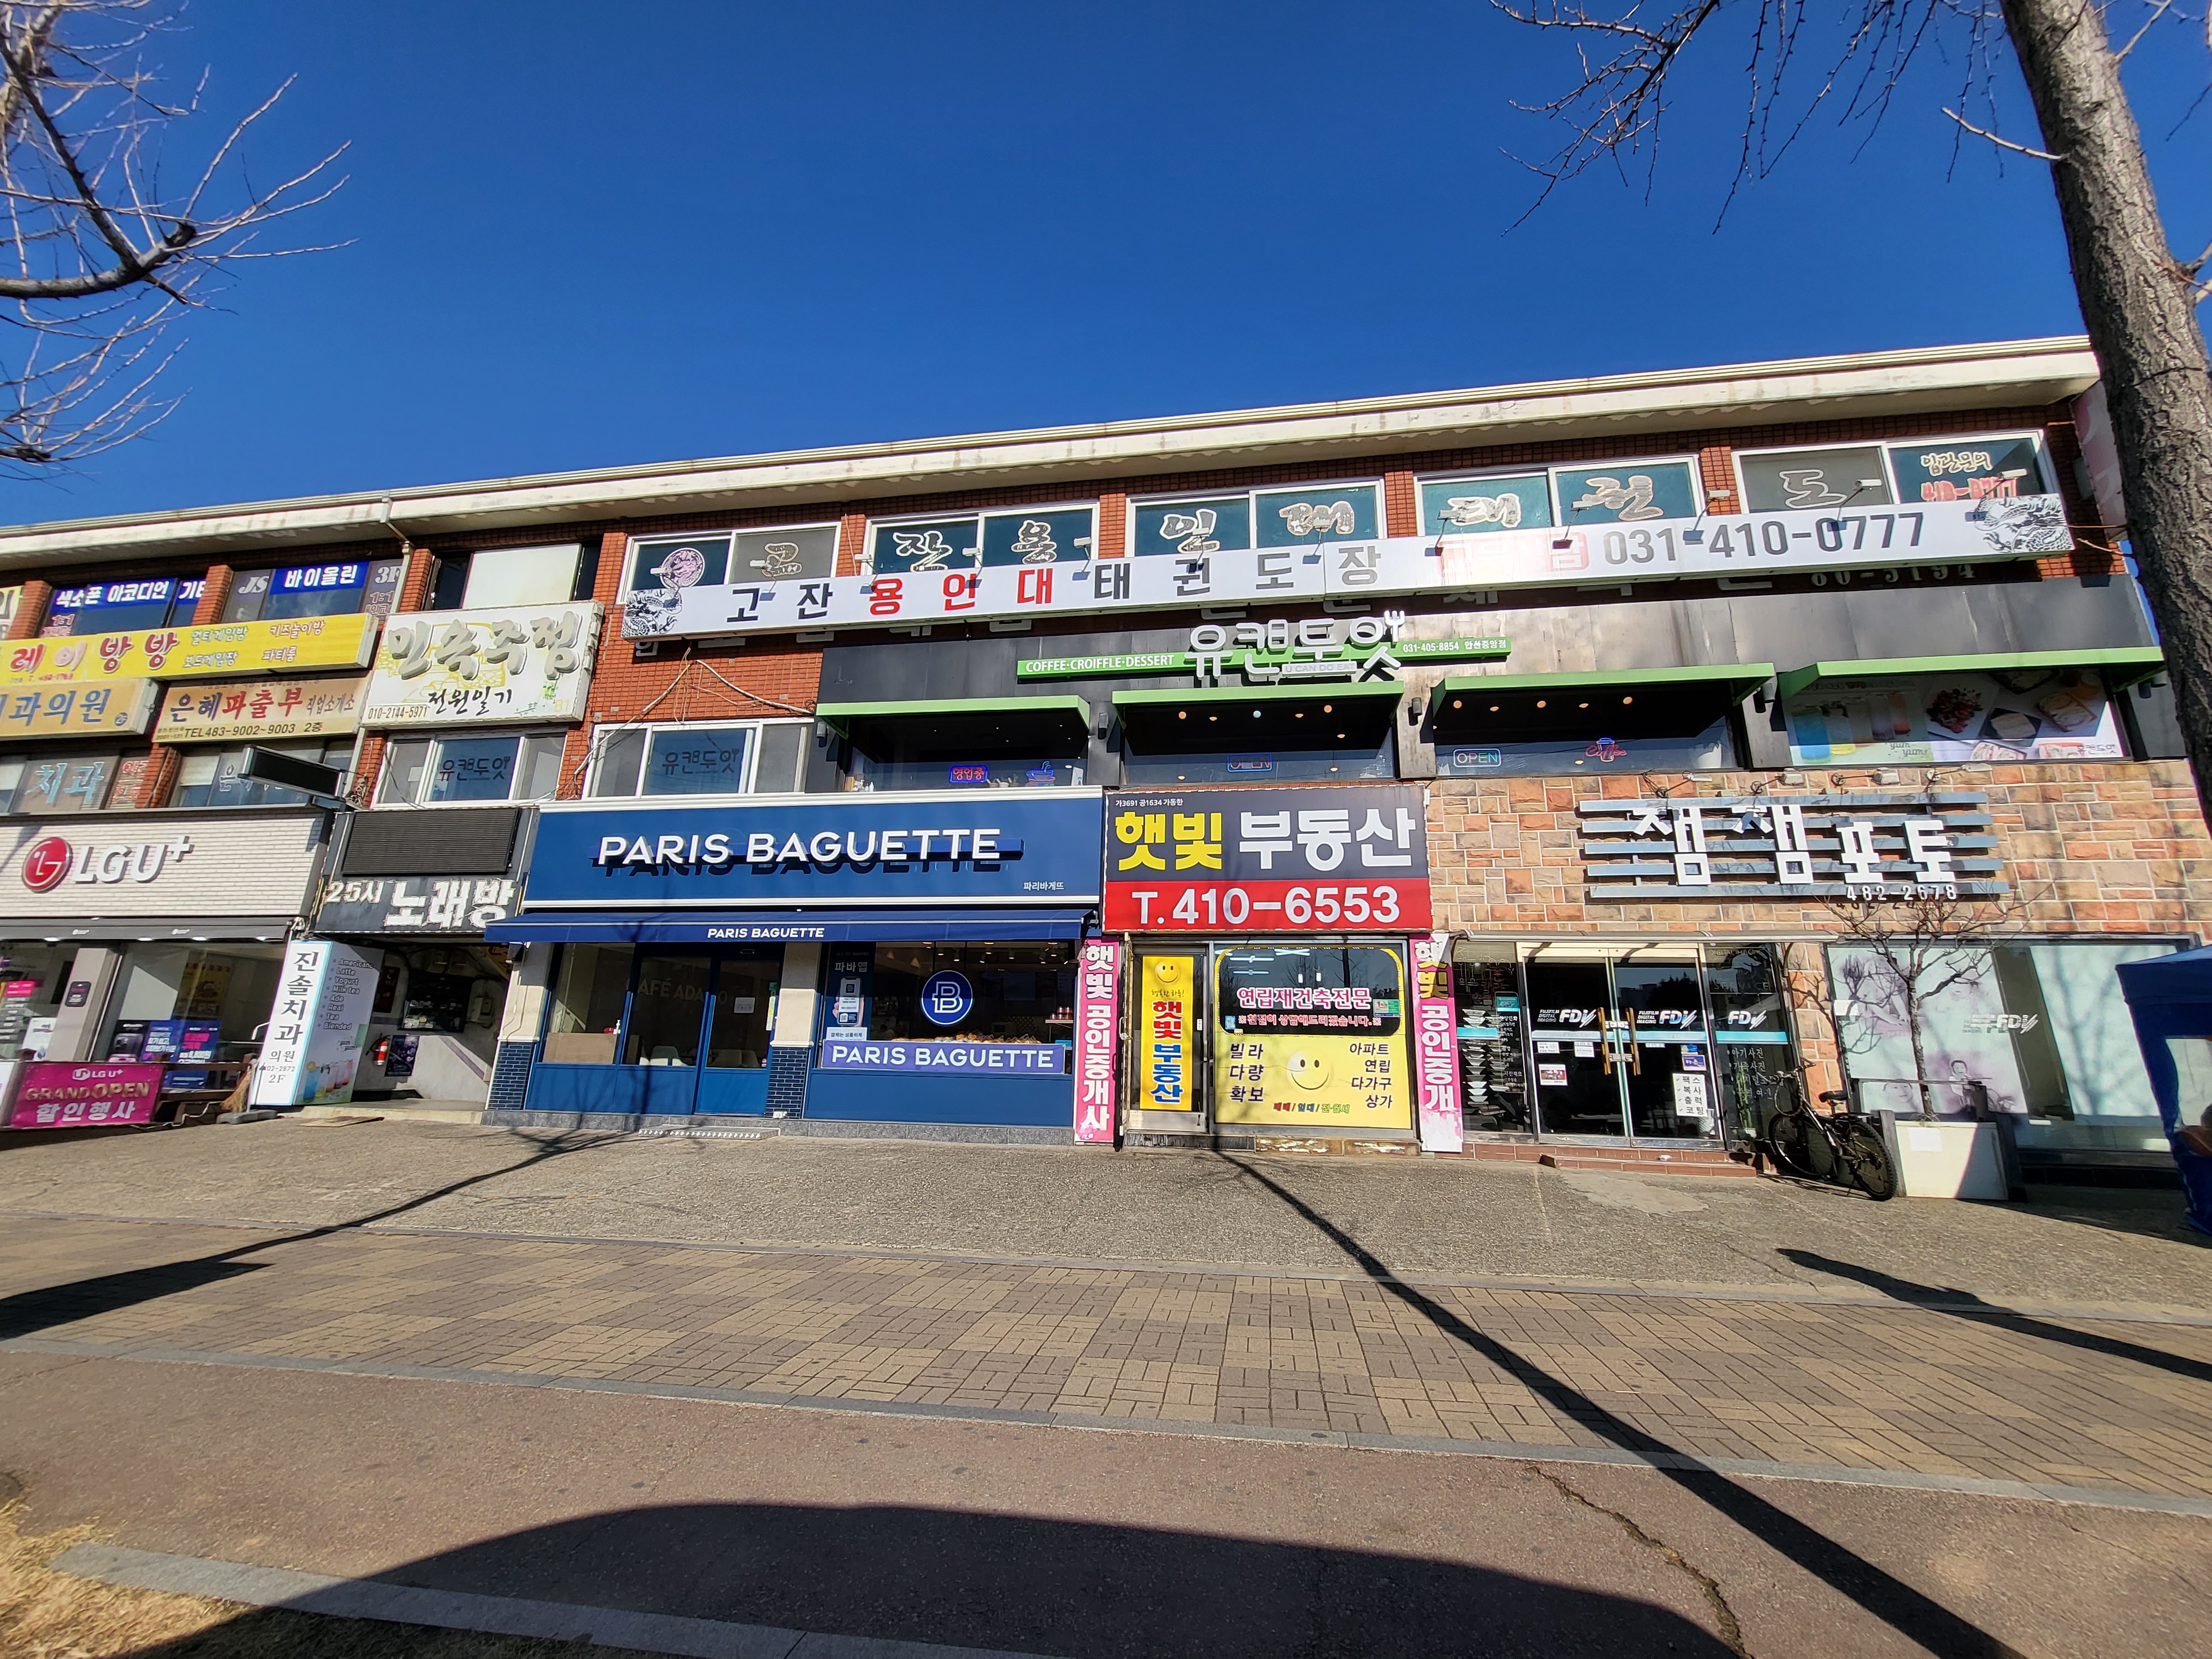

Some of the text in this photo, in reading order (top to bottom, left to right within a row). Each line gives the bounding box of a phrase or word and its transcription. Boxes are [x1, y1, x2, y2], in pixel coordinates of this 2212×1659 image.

[1920, 451, 1993, 476] 입관문의
[284, 565, 358, 589] 바이올린
[238, 576, 269, 594] JS
[56, 585, 103, 607] 색소폰
[107, 581, 169, 602] 아코디언
[370, 591, 395, 603] 1:1
[191, 620, 326, 645] 멀티게임방 키즈놀이방
[0, 631, 180, 674] 레이방방
[388, 611, 584, 681] 민속주점
[1403, 641, 1460, 653] 031-405-8854
[182, 646, 297, 668] 보드게임장 파티룸
[1285, 663, 1355, 673] U CAN DO EAT
[306, 693, 354, 716] 직업소개소
[427, 686, 513, 716] 전원일기
[367, 706, 428, 719] 010-2144-5971
[304, 722, 323, 733] 2층
[1457, 752, 1498, 764] OPEN
[1585, 744, 1627, 759] Coffee
[952, 767, 985, 780] 영업중
[25, 761, 106, 804] 치과
[1139, 799, 1162, 807] 공1634
[1163, 798, 1183, 806] 가동한
[598, 828, 1001, 865] PARIS BAGUETTE
[1115, 807, 1416, 871] 햇빛 부동산
[1633, 805, 1957, 885] 잼잼포토
[1022, 879, 1065, 891] 파리바게뜨
[1846, 885, 1957, 901] 482-2678
[325, 878, 516, 929] 25시 노래방
[707, 927, 825, 938] PARIS BAGUETTE
[338, 958, 374, 968] Americano
[834, 961, 868, 973] 파바앱
[336, 968, 356, 976] Latte
[335, 976, 359, 985] Yogurt
[332, 985, 347, 994] Milk
[626, 977, 728, 1005] AFÉ ADAO
[274, 951, 319, 1045] 진솔치과
[1237, 987, 1372, 1010] 연립재건축전문
[324, 1022, 352, 1031] Blended
[1080, 945, 1114, 1132] 햇빛 공인중개사
[832, 1045, 1053, 1067] PARIS BAGUETTE
[1149, 1000, 1183, 1104] 햇빛 부동산
[1230, 1043, 1264, 1060] 빌라
[1349, 1042, 1390, 1056] 아파트
[1731, 1047, 1764, 1059] 아기사진
[269, 1051, 295, 1063] 의원
[1421, 1005, 1457, 1120] 공인중개
[1229, 1065, 1264, 1081] 다량
[1364, 1060, 1391, 1073] 연립
[1733, 1061, 1766, 1073] 가족사진
[268, 1074, 285, 1083] 2F
[1351, 1076, 1392, 1091] 다가구
[1682, 1076, 1700, 1084] 팩스
[1229, 1086, 1264, 1103] 확보
[1683, 1086, 1702, 1094] 복사
[1365, 1095, 1393, 1109] 상가
[1684, 1096, 1703, 1105] 출력
[36, 1101, 136, 1123] 할인행사
[1686, 1107, 1704, 1115] 코팅
